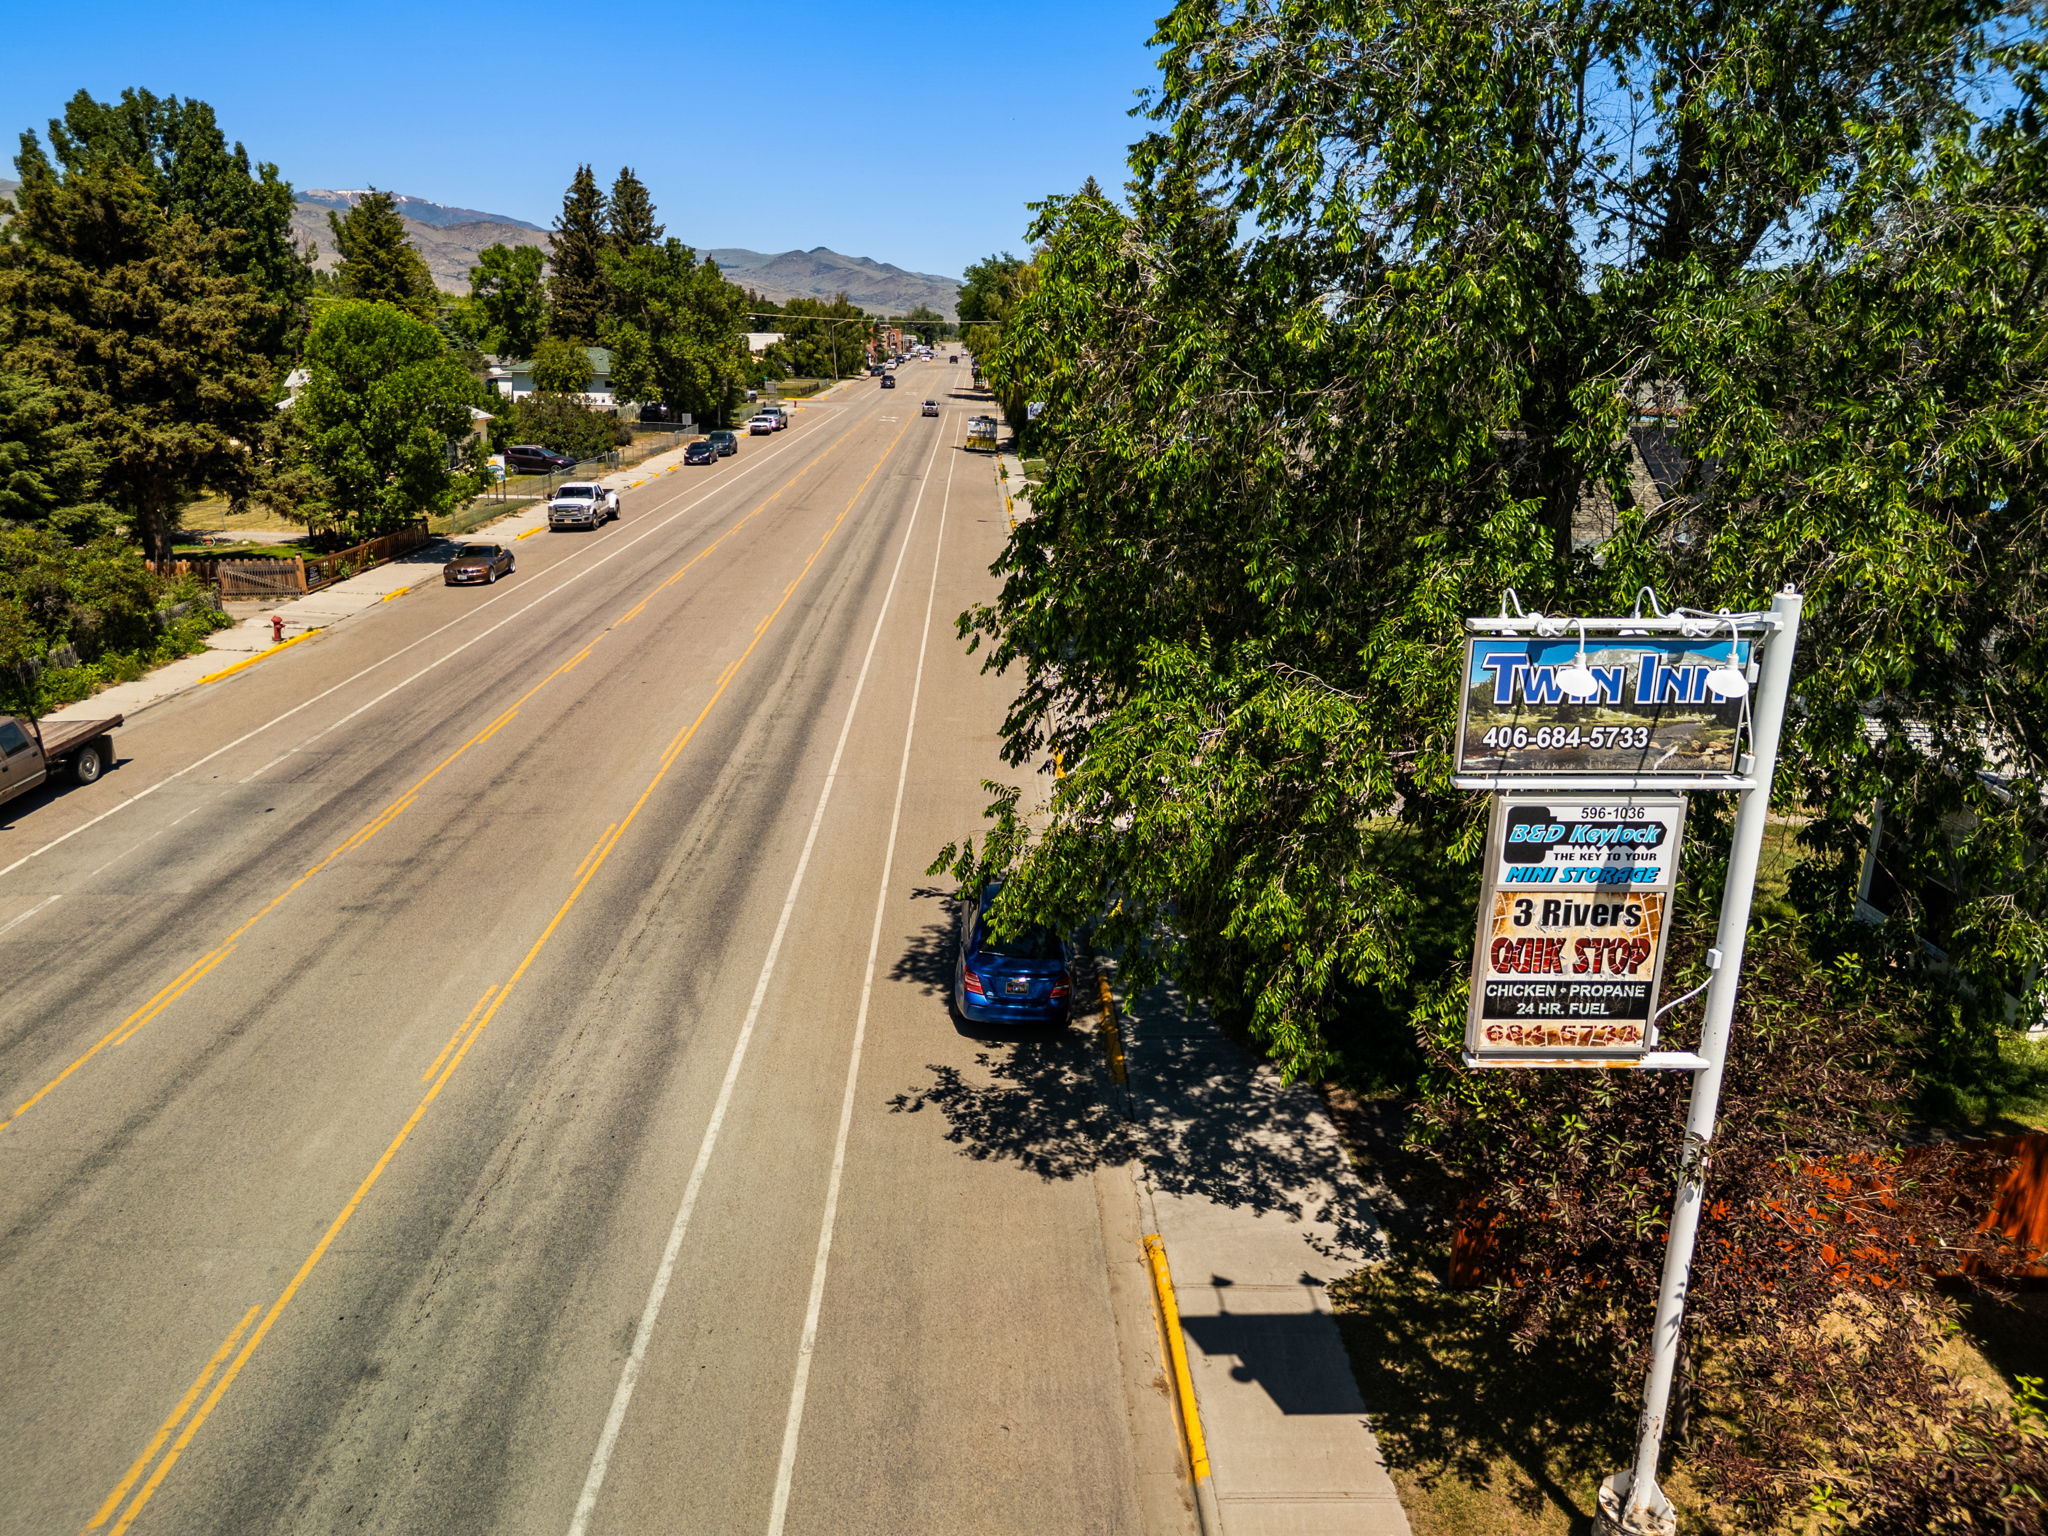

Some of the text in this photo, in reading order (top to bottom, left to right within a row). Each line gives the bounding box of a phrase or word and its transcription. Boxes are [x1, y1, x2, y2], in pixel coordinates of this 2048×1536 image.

[1481, 652, 1626, 704] TWN
[1482, 726, 1648, 748] 406-684-5733
[1581, 807, 1645, 819] 596-1036
[1508, 824, 1661, 847] B&D Keylock
[1553, 852, 1657, 861] THE KEY TO YOUR
[1505, 867, 1661, 884] MINI STORAGE
[1513, 898, 1642, 926] 3 Rivers
[1490, 937, 1652, 975] QUIK STOP
[1486, 984, 1646, 997] CHICKEN PROPANE
[1516, 1003, 1610, 1014] 24 HR. FUEL
[1486, 1025, 1638, 1042] 684 5733
